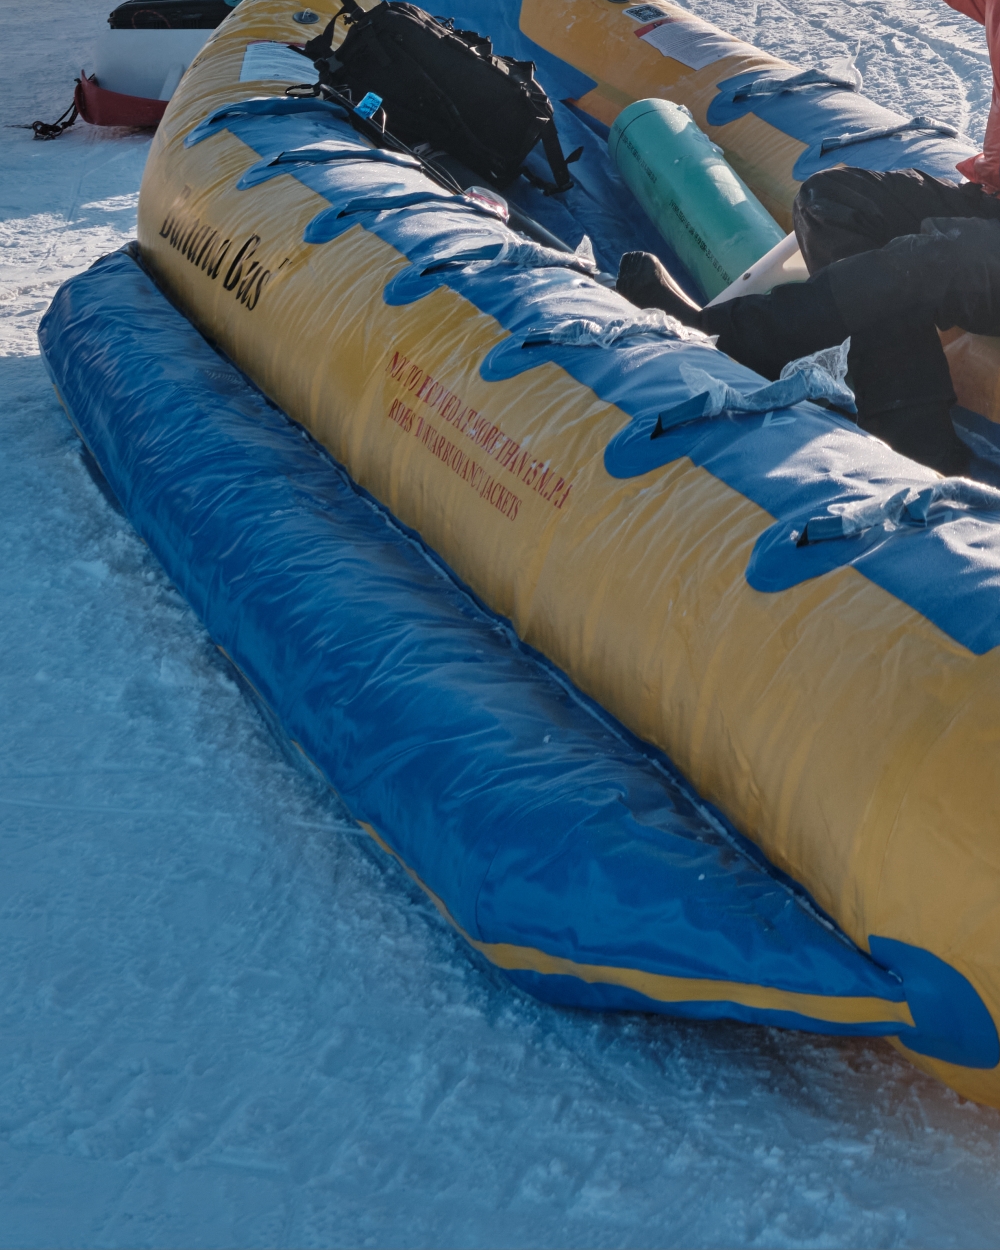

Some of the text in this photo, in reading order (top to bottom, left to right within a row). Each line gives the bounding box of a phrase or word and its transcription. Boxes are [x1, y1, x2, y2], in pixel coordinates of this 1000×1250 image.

[222, 232, 272, 312] Bus
[420, 423, 446, 459] WEAR
[440, 440, 487, 492] BUOYANCY
[479, 474, 524, 522] JACKETS
[451, 405, 478, 433] AT
[465, 415, 506, 456] MORE
[494, 436, 532, 478] THAN
[521, 458, 545, 487] 15
